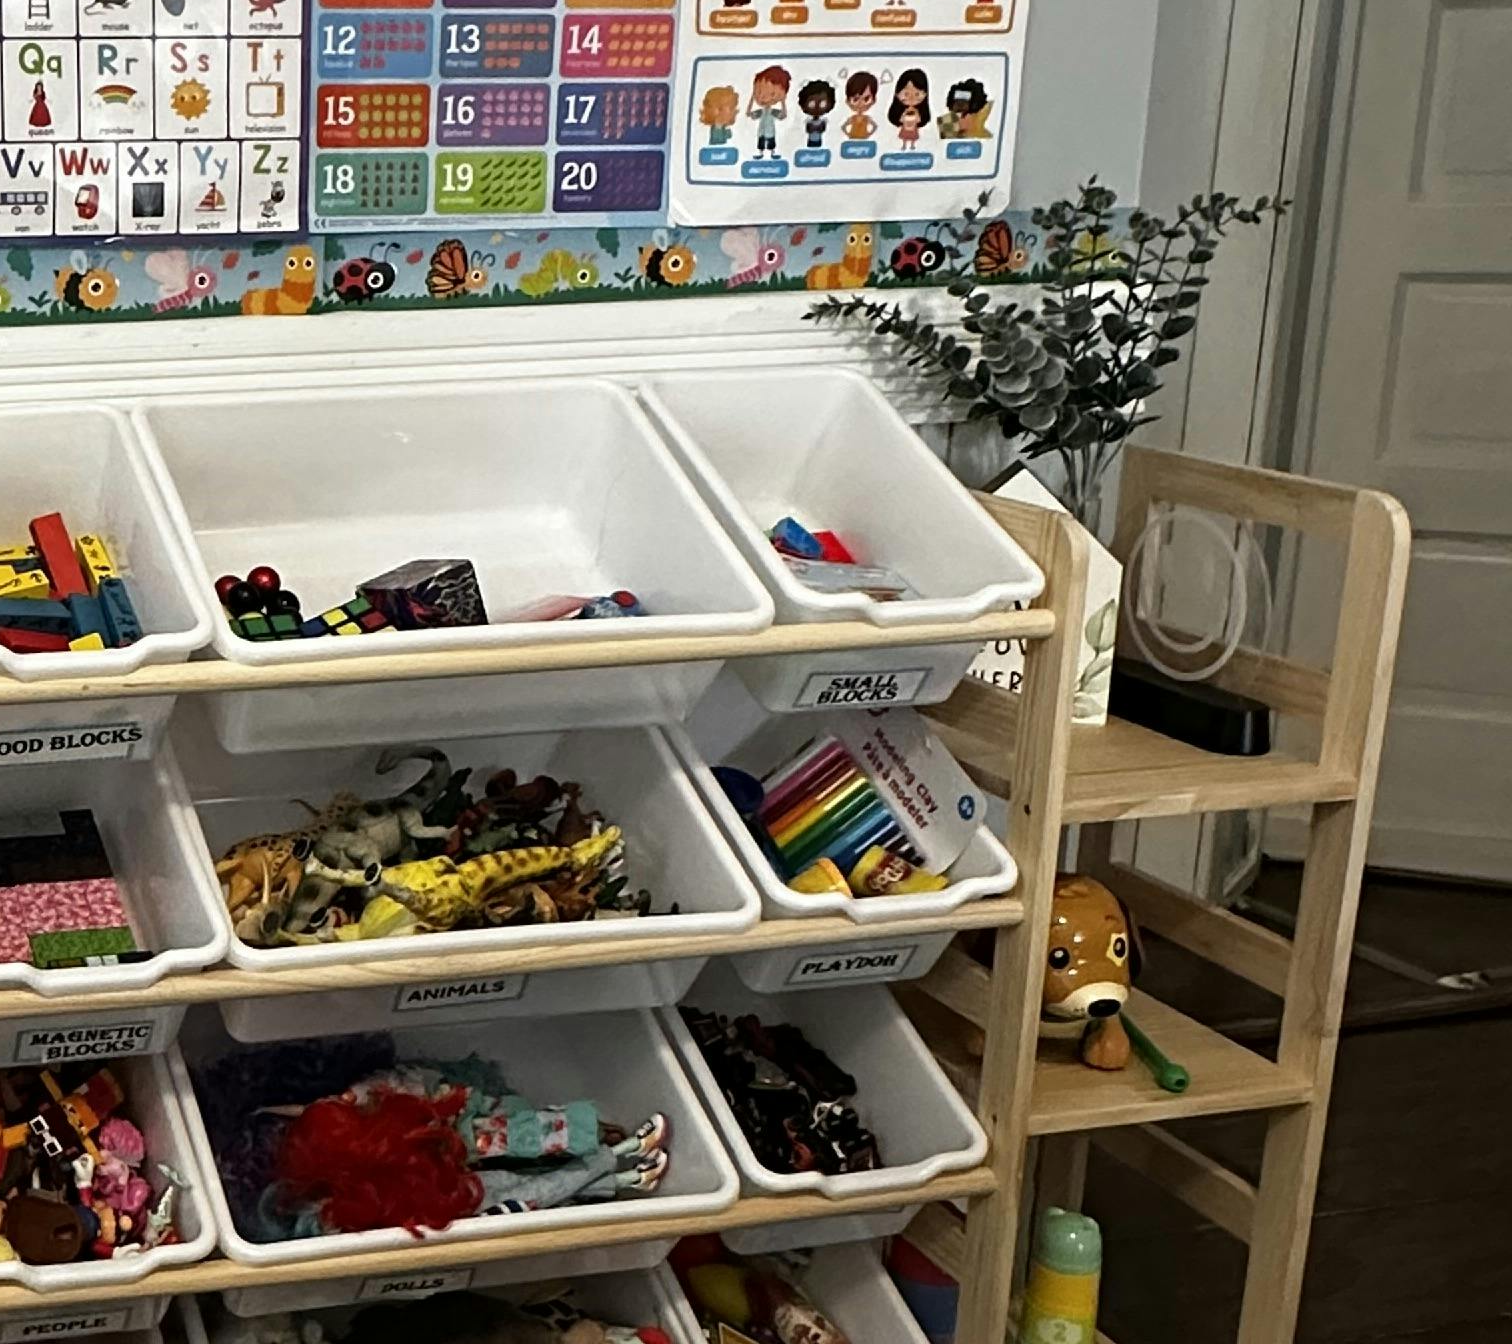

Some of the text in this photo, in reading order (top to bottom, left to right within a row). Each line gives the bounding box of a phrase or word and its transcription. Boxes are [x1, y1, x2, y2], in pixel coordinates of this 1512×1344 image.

[322, 25, 356, 55] 12
[445, 24, 481, 54] 13
[566, 24, 603, 55] 14
[18, 43, 62, 79] Qq
[98, 44, 139, 76] Rr
[170, 43, 210, 73] Ss
[247, 42, 284, 72] Tt
[323, 94, 356, 126] 15
[442, 95, 475, 125] 16
[563, 95, 596, 125] 17
[1, 148, 44, 179] Vv
[59, 147, 110, 177] Ww
[127, 146, 168, 176] Xx
[192, 145, 228, 180] Yy
[252, 145, 289, 175] Zz
[322, 164, 355, 195] 18
[441, 162, 474, 192] 19
[560, 161, 598, 191] 20
[817, 687, 898, 704] BLOCKS
[828, 674, 898, 690] SMALL
[49, 728, 143, 752] BLOCKS
[873, 727, 939, 815] Modeling Clay
[887, 778, 929, 830] modeler
[800, 954, 898, 975] PLAYDOH
[406, 978, 506, 1003] ANIMALS
[30, 1025, 150, 1046] MAGNETIC
[47, 1039, 135, 1060] BLOCKS
[380, 1276, 445, 1294] DOLLS
[22, 1315, 108, 1336] PEOPLE
